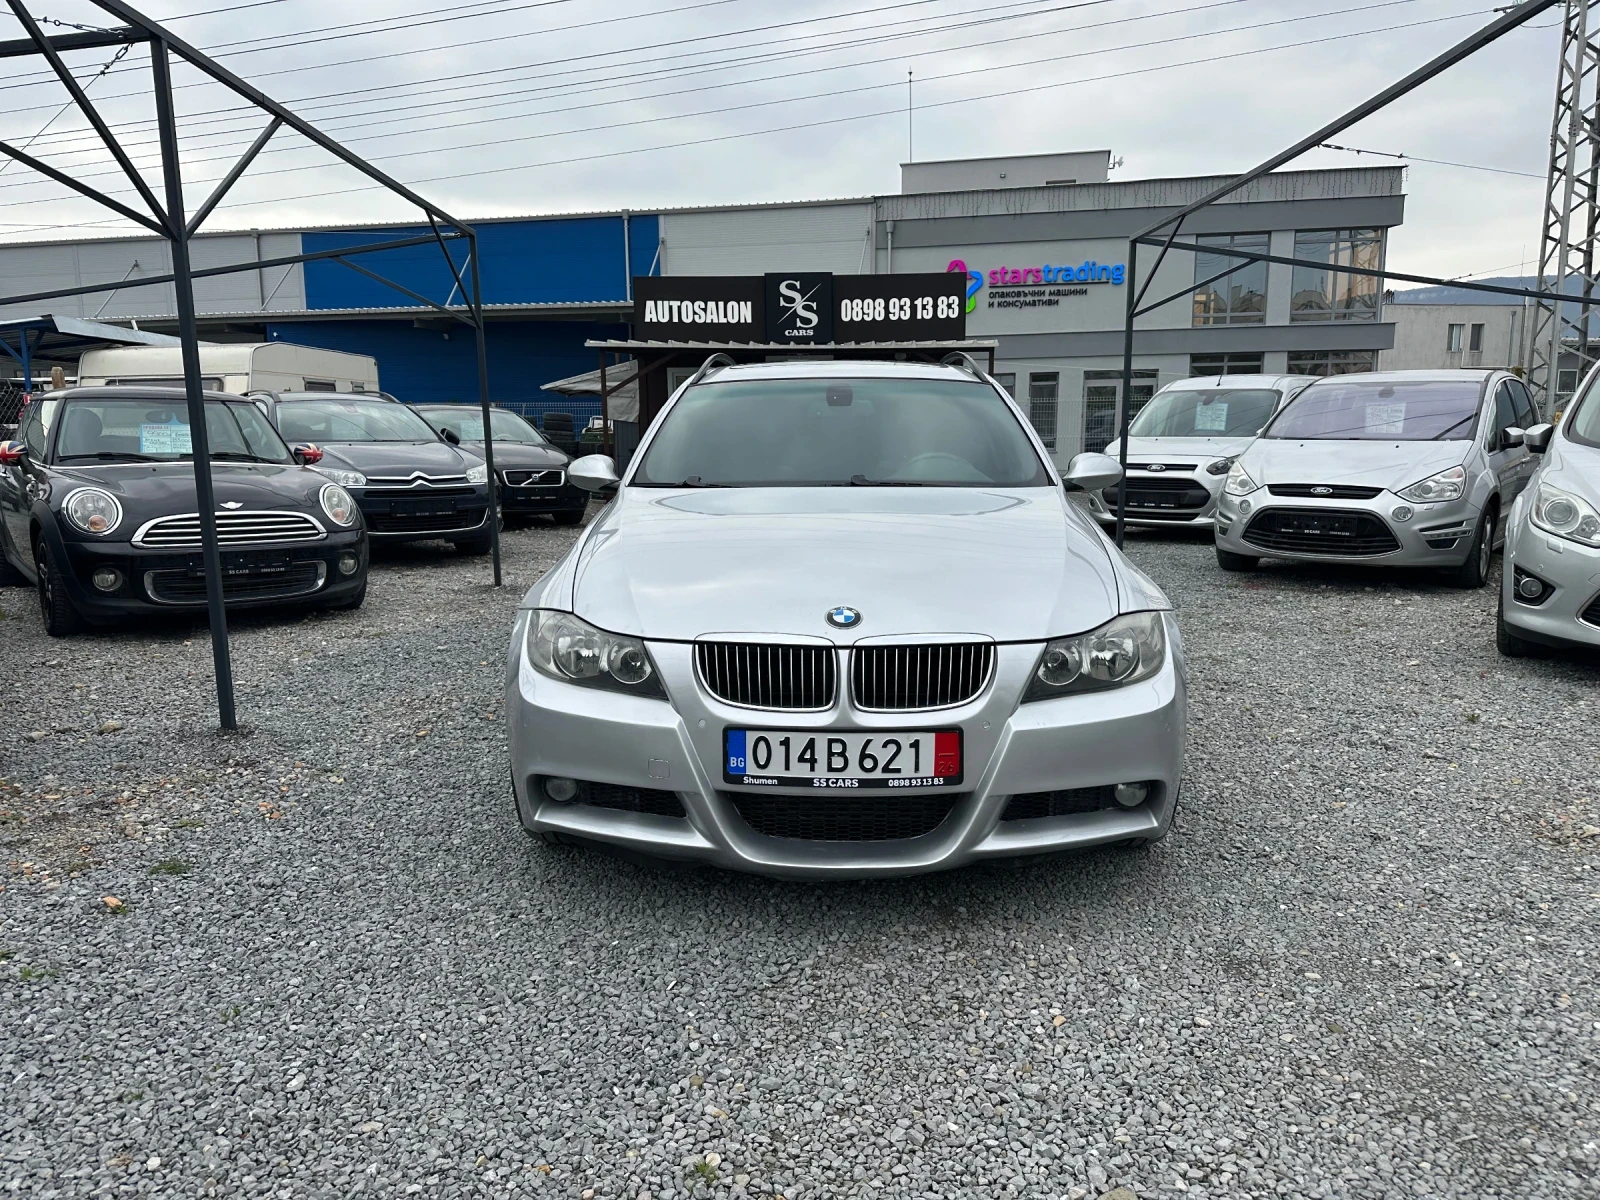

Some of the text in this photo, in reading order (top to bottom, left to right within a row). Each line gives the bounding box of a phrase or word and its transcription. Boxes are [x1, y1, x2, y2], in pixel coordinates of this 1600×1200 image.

[988, 261, 1125, 285] starstrading
[988, 288, 1088, 299] опаковъчни машини
[841, 295, 959, 322] 0898 93 13 83
[997, 298, 1059, 309] консумативи
[644, 300, 752, 324] AUTOSALON
[730, 757, 745, 767] BG
[939, 761, 955, 773] 26
[743, 776, 778, 785] Shumen
[813, 778, 859, 788] SS CARS
[888, 777, 944, 787] 0898 93 13 83
